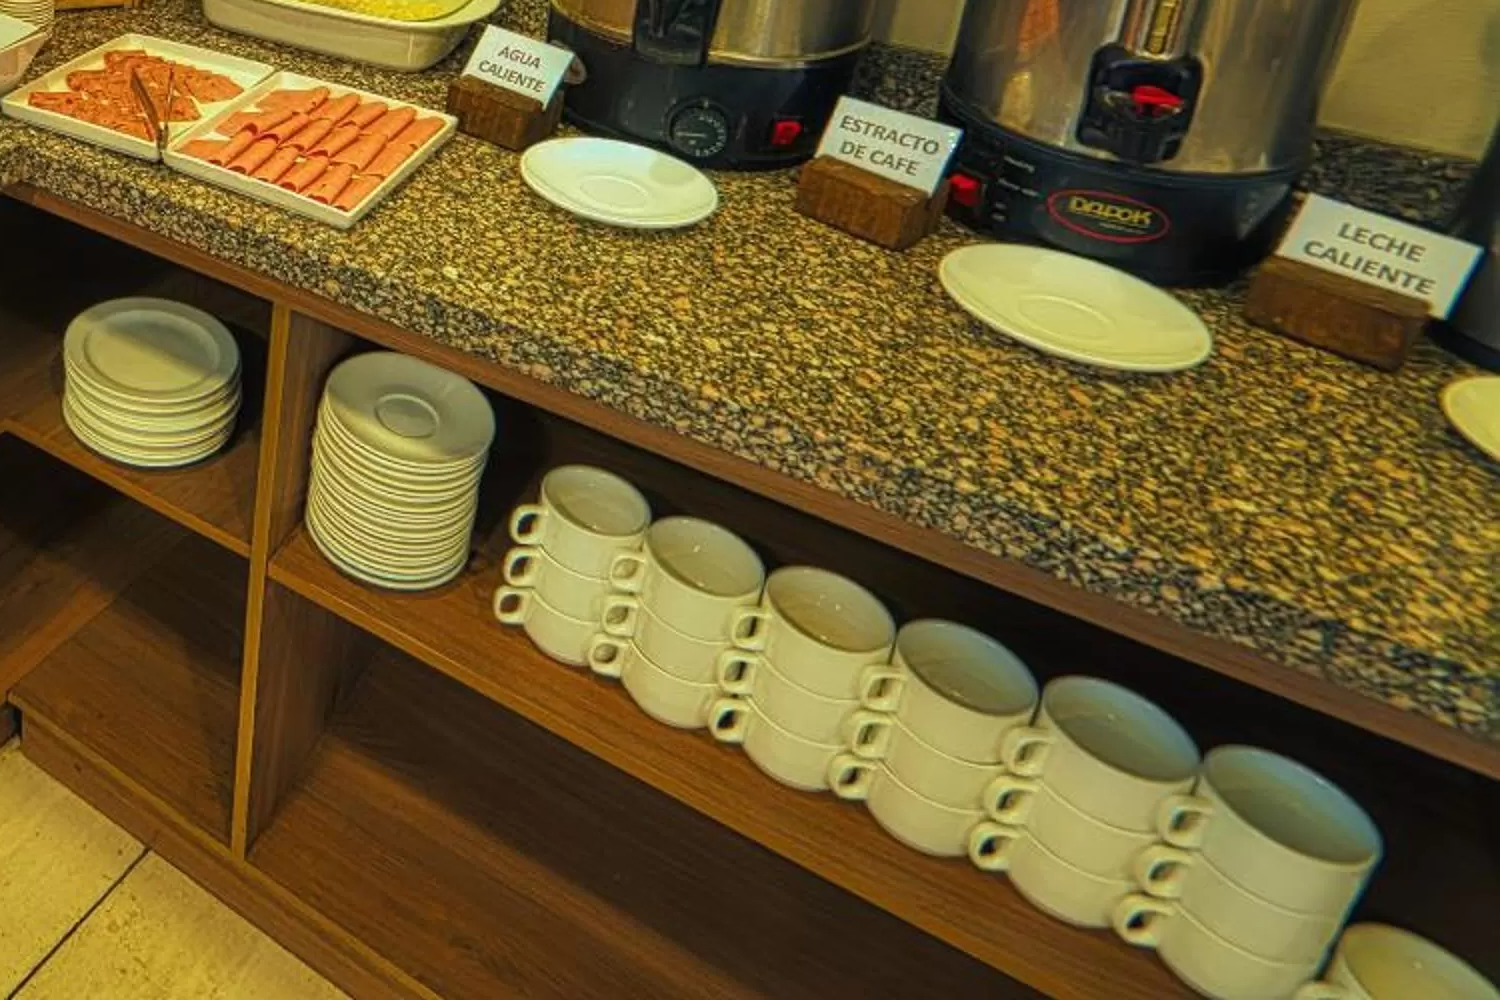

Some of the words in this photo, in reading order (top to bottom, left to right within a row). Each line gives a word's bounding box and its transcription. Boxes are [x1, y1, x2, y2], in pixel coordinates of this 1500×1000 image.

[498, 46, 541, 68] AGUA
[479, 61, 546, 92] CALIENTE
[840, 115, 939, 154] ESTRACTO
[839, 141, 866, 159] DE
[869, 150, 919, 176] CAFE
[1338, 223, 1426, 262] LECHE
[1303, 240, 1436, 295] CALIENTE
